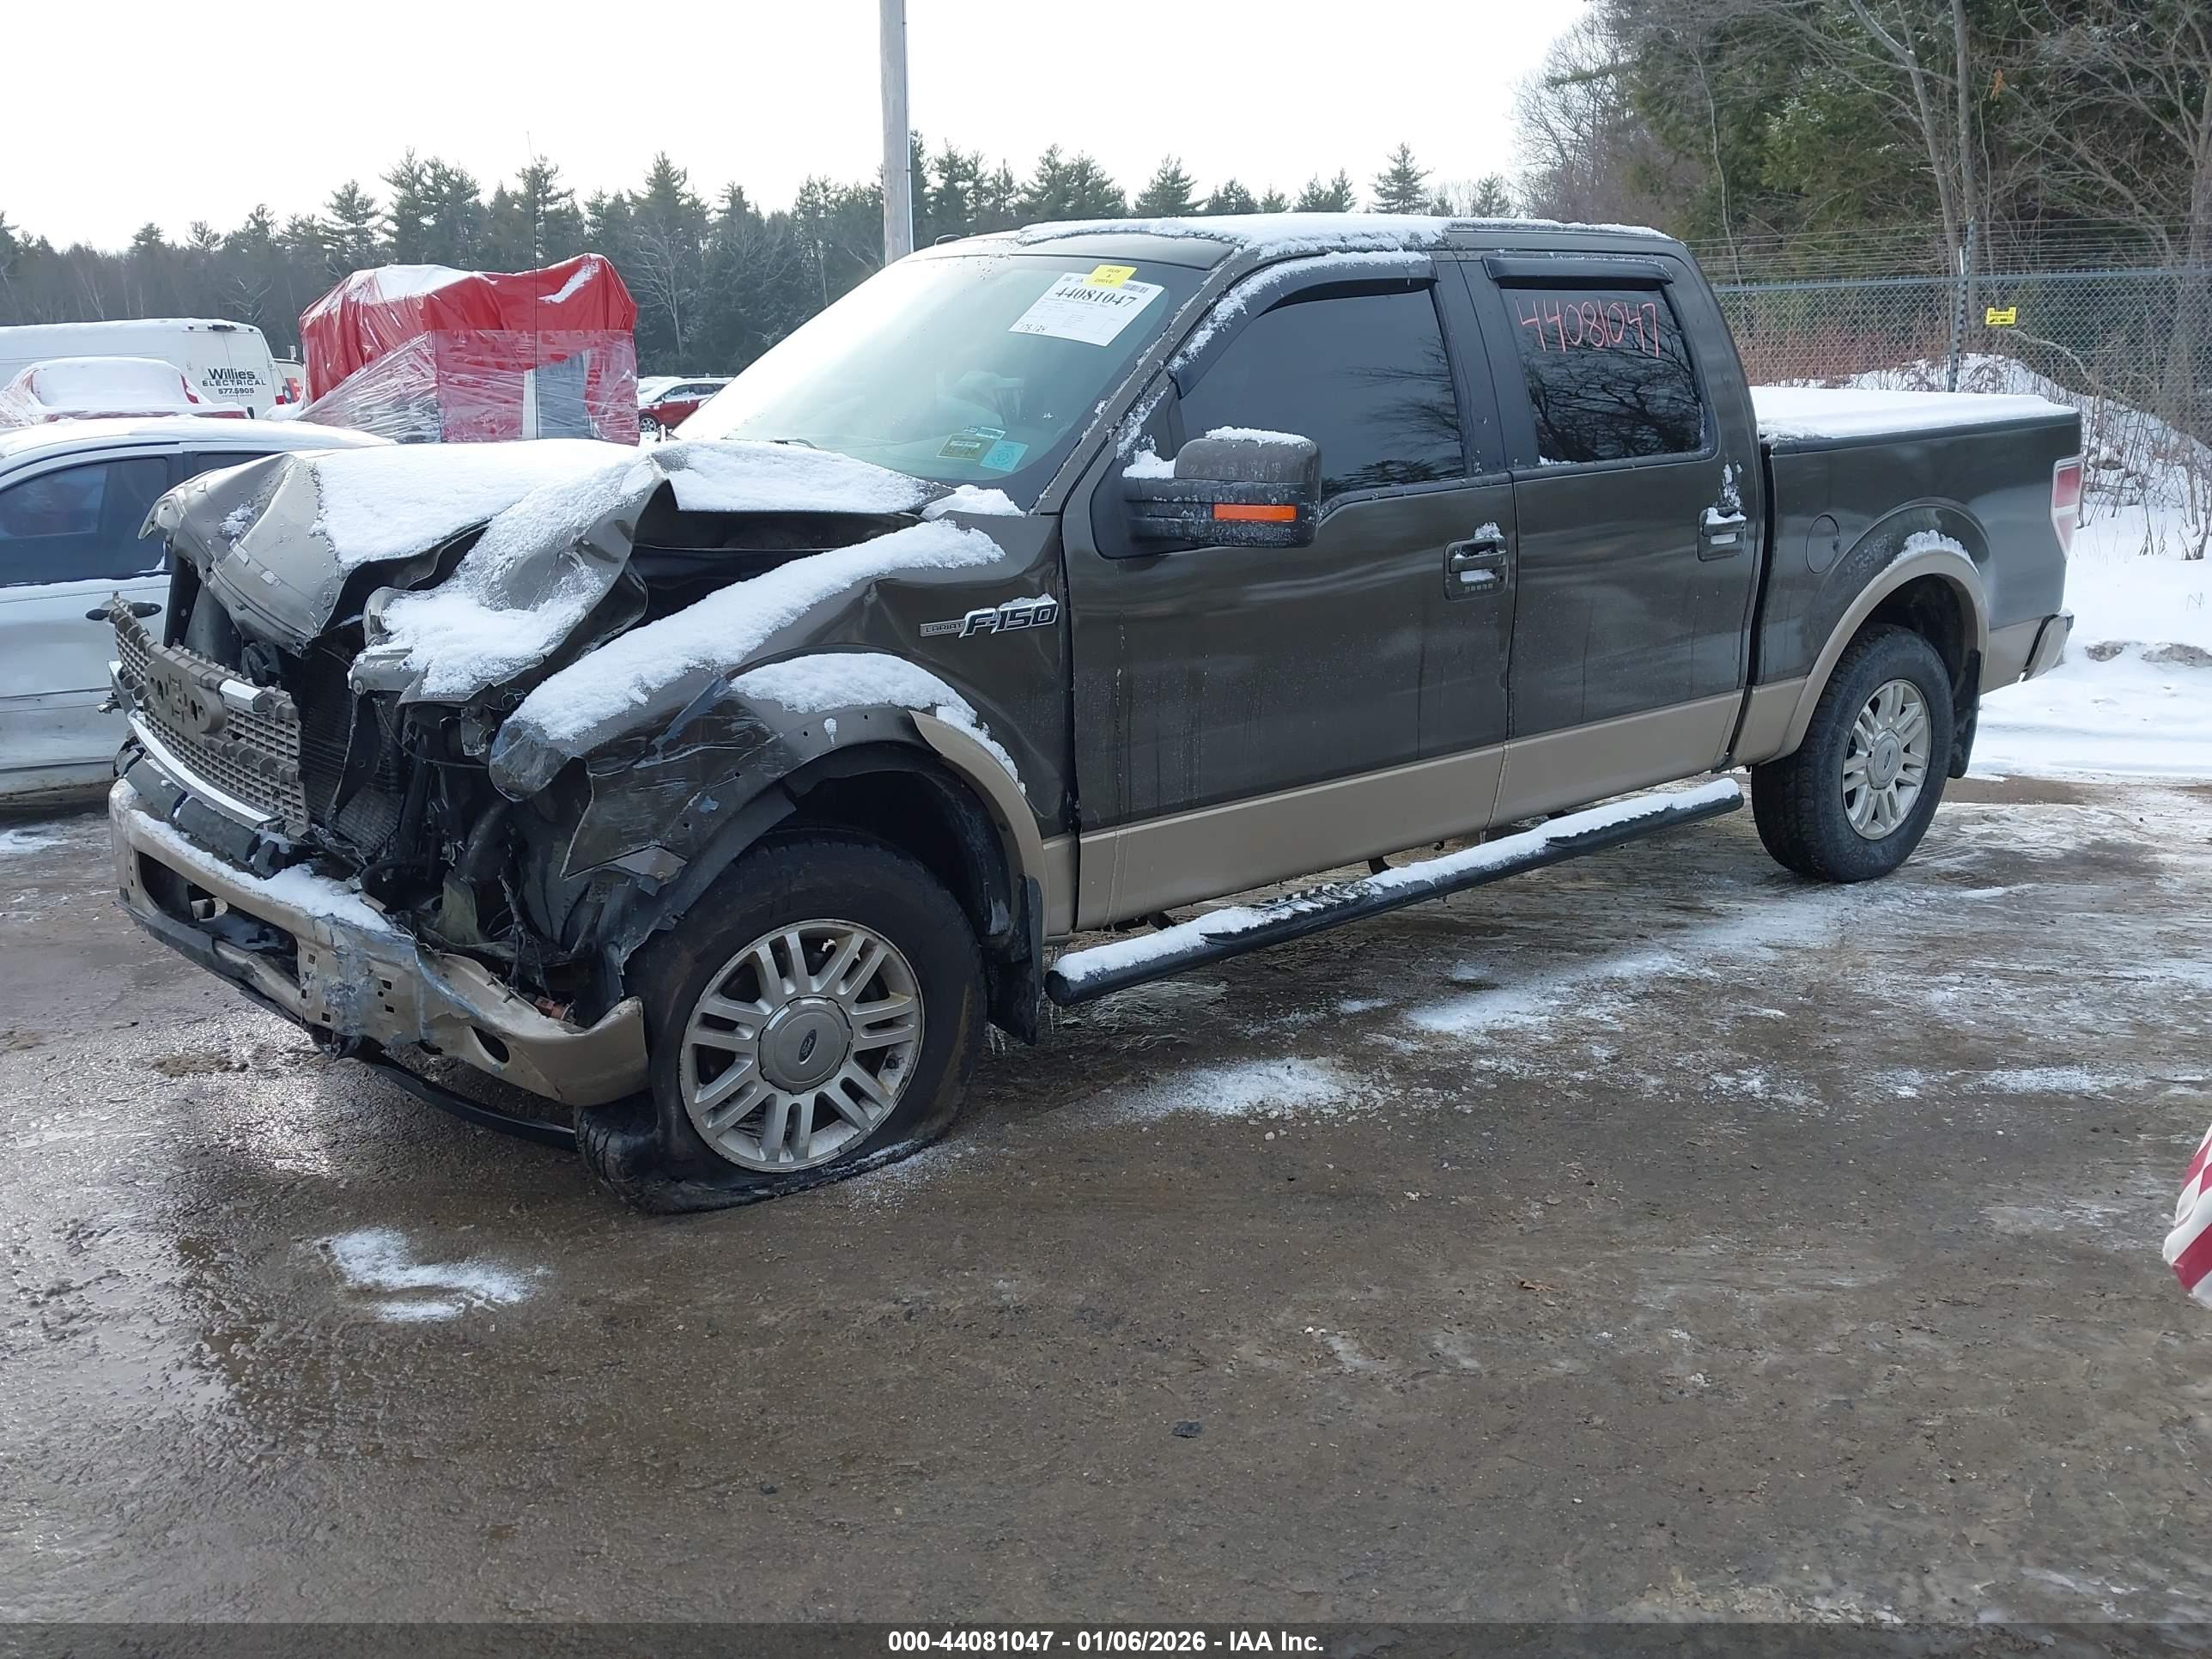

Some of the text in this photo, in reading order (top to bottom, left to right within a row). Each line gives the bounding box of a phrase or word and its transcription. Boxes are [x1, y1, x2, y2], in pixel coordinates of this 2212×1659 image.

[1055, 287, 1137, 309] 44081047
[1516, 299, 1659, 358] 44081047
[926, 623, 963, 633] LARIAT
